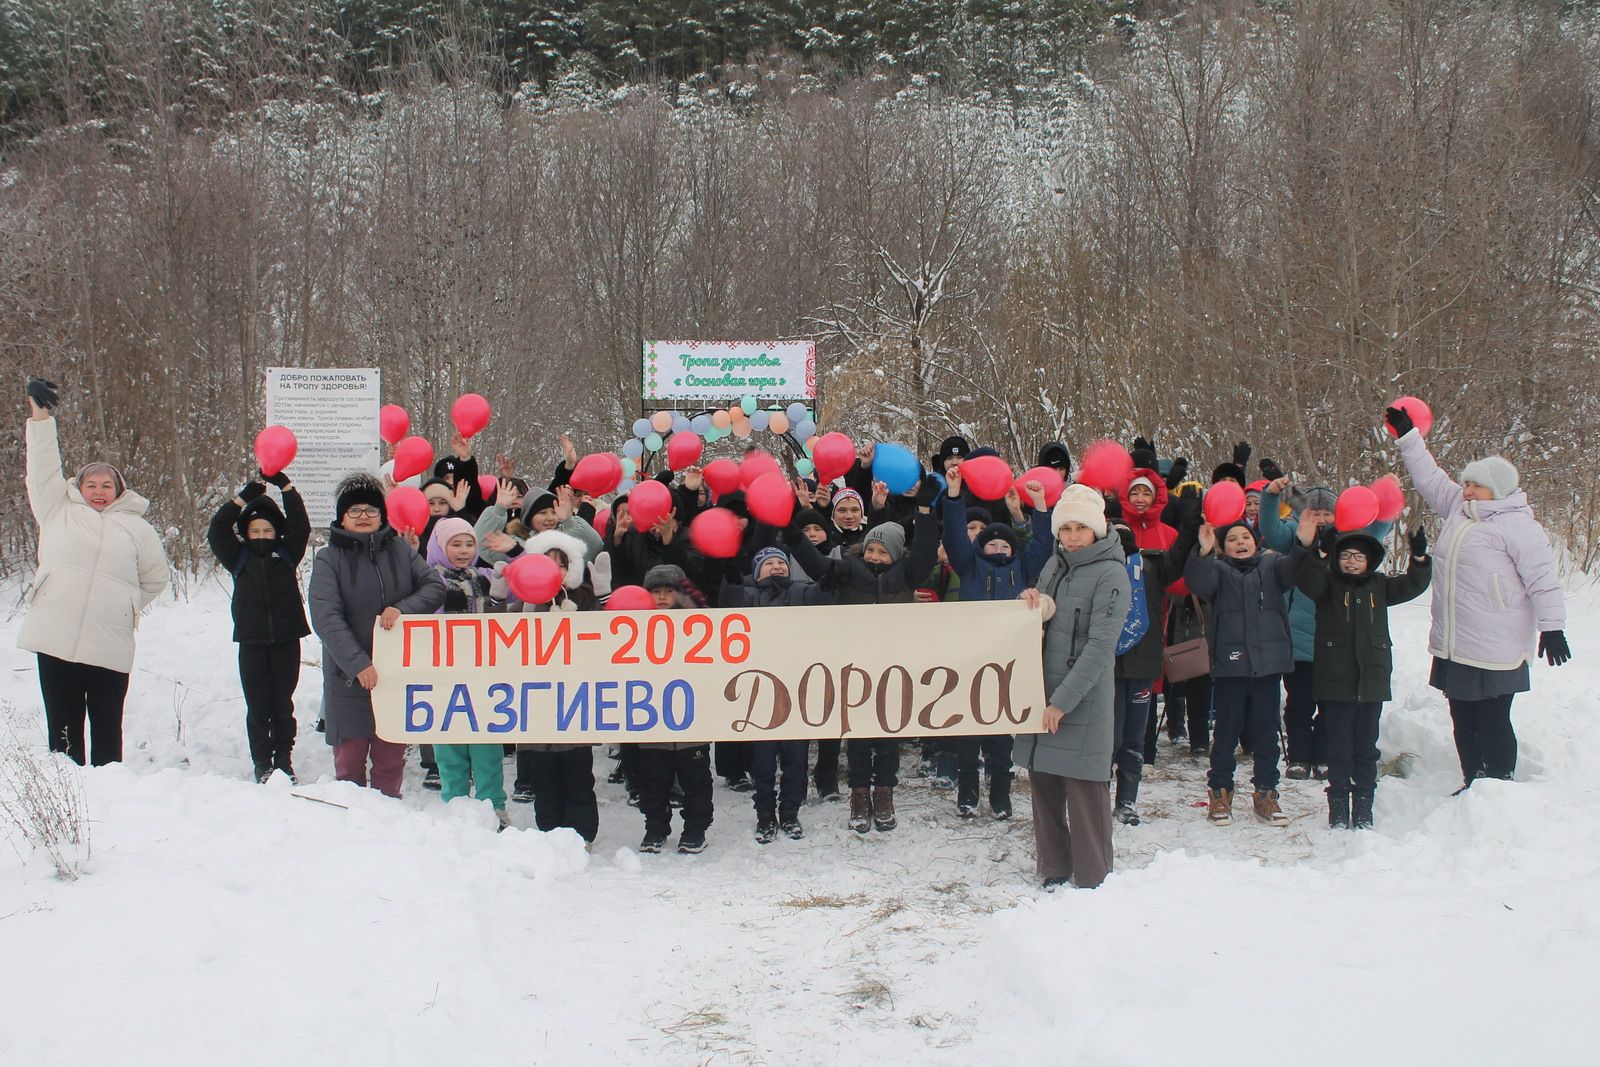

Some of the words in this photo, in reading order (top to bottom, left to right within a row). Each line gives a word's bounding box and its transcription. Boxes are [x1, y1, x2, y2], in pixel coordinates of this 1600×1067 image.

[679, 354, 720, 371] Тропа
[720, 353, 782, 371] здоровья
[321, 383, 367, 391] ЗДОРОВЬЯ!
[685, 373, 746, 387] Сосновая
[749, 378, 777, 391] гора
[402, 613, 751, 667] ППМИ-2026
[405, 679, 695, 732] БАЗГИЕВО
